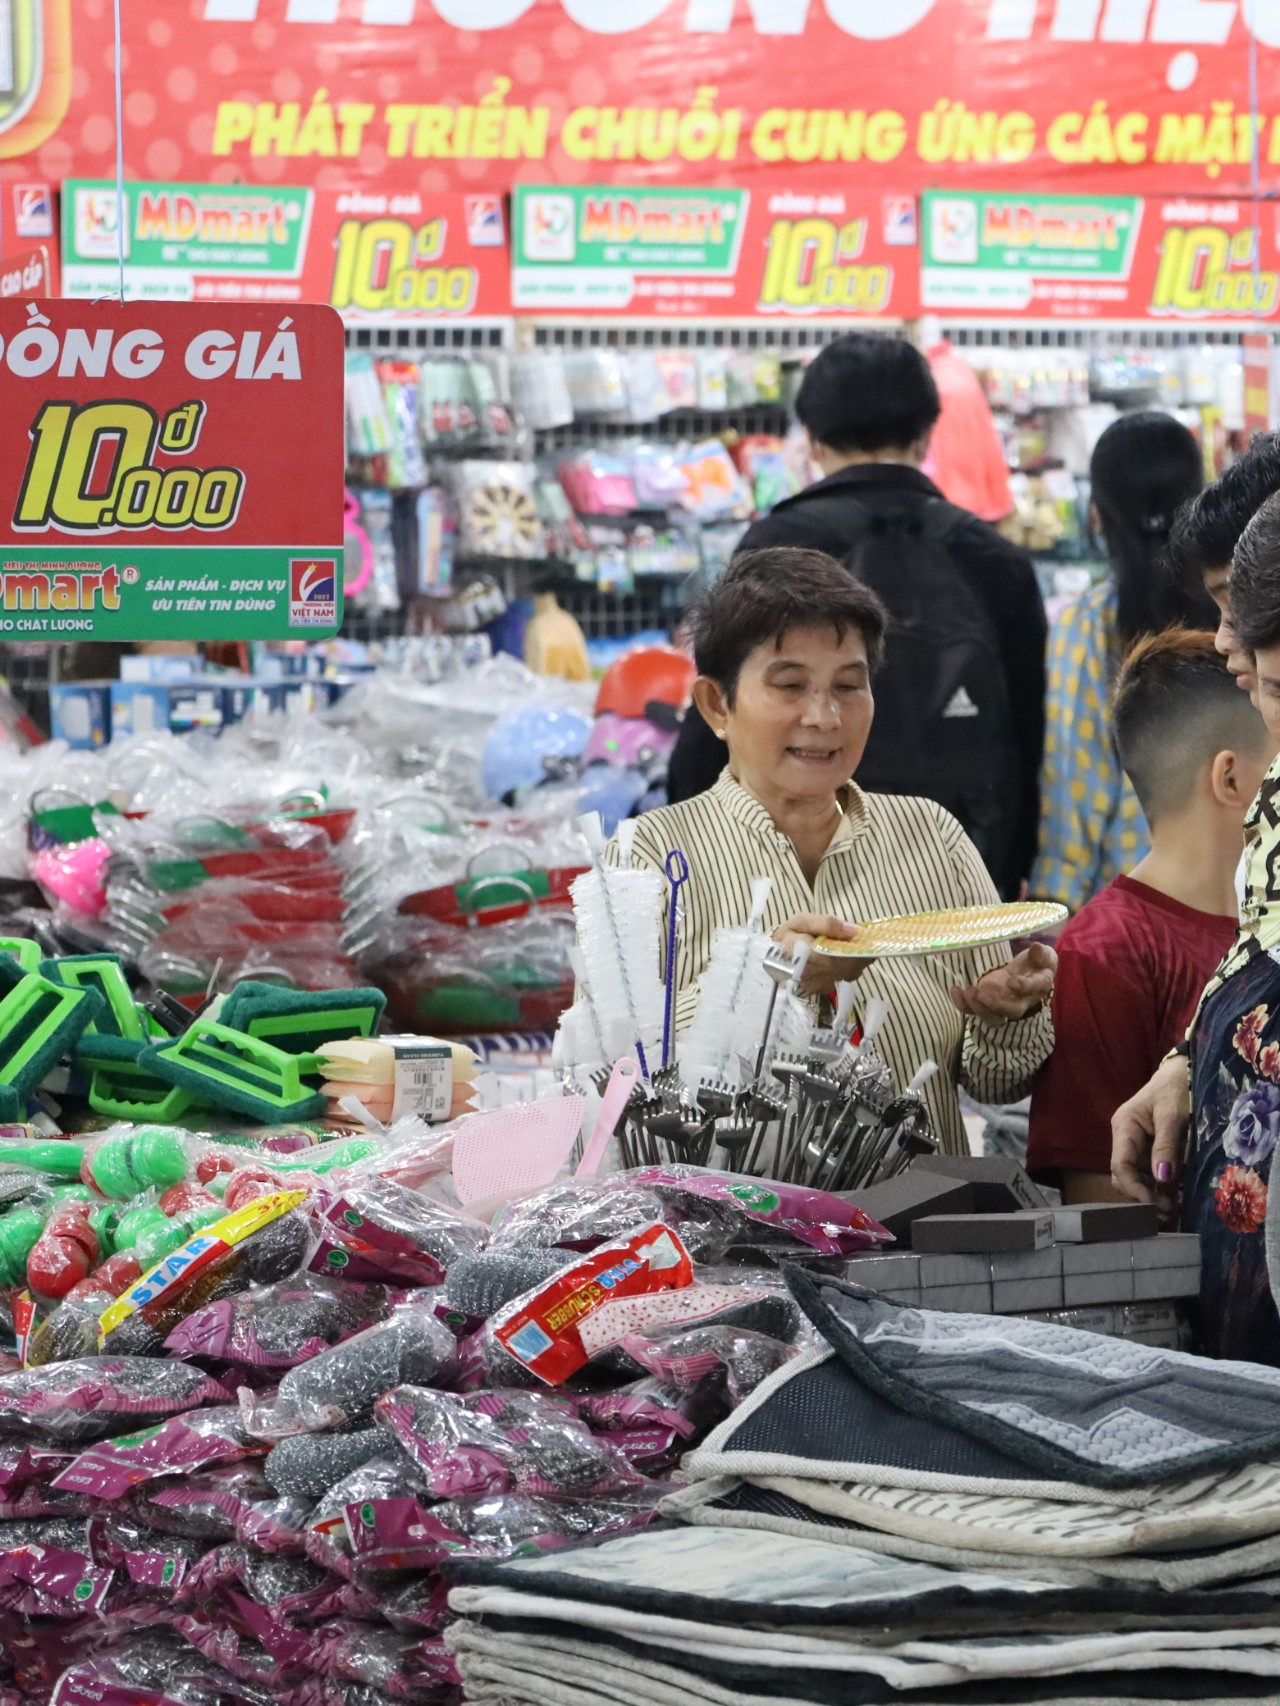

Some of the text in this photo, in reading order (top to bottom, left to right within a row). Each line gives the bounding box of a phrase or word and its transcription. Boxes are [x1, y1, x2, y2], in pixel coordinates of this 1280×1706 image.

[213, 88, 374, 156] PHÁT
[385, 76, 549, 159] TRIỂN
[751, 107, 907, 163] CUNG
[917, 97, 1035, 163] ỨNG
[1046, 101, 1149, 164] CÁC
[135, 190, 290, 245] MDmart
[579, 194, 725, 244] MDmart
[983, 203, 1119, 250] MDmart
[0, 302, 302, 380] ỒNG GIÁ
[0, 563, 121, 611] mart
[41, 561, 65, 571] MINH
[145, 576, 175, 591] SẢN
[177, 573, 218, 591] PHẨM
[230, 579, 264, 594] DỊCH
[267, 579, 286, 594] VỤ
[176, 596, 206, 611] TIÊN
[209, 599, 232, 611] TIN
[234, 596, 276, 611] DÙNG
[292, 606, 334, 618] VIỆT NAM
[131, 1237, 212, 1306] STAR
[546, 1285, 601, 1331] SCRUBBER
